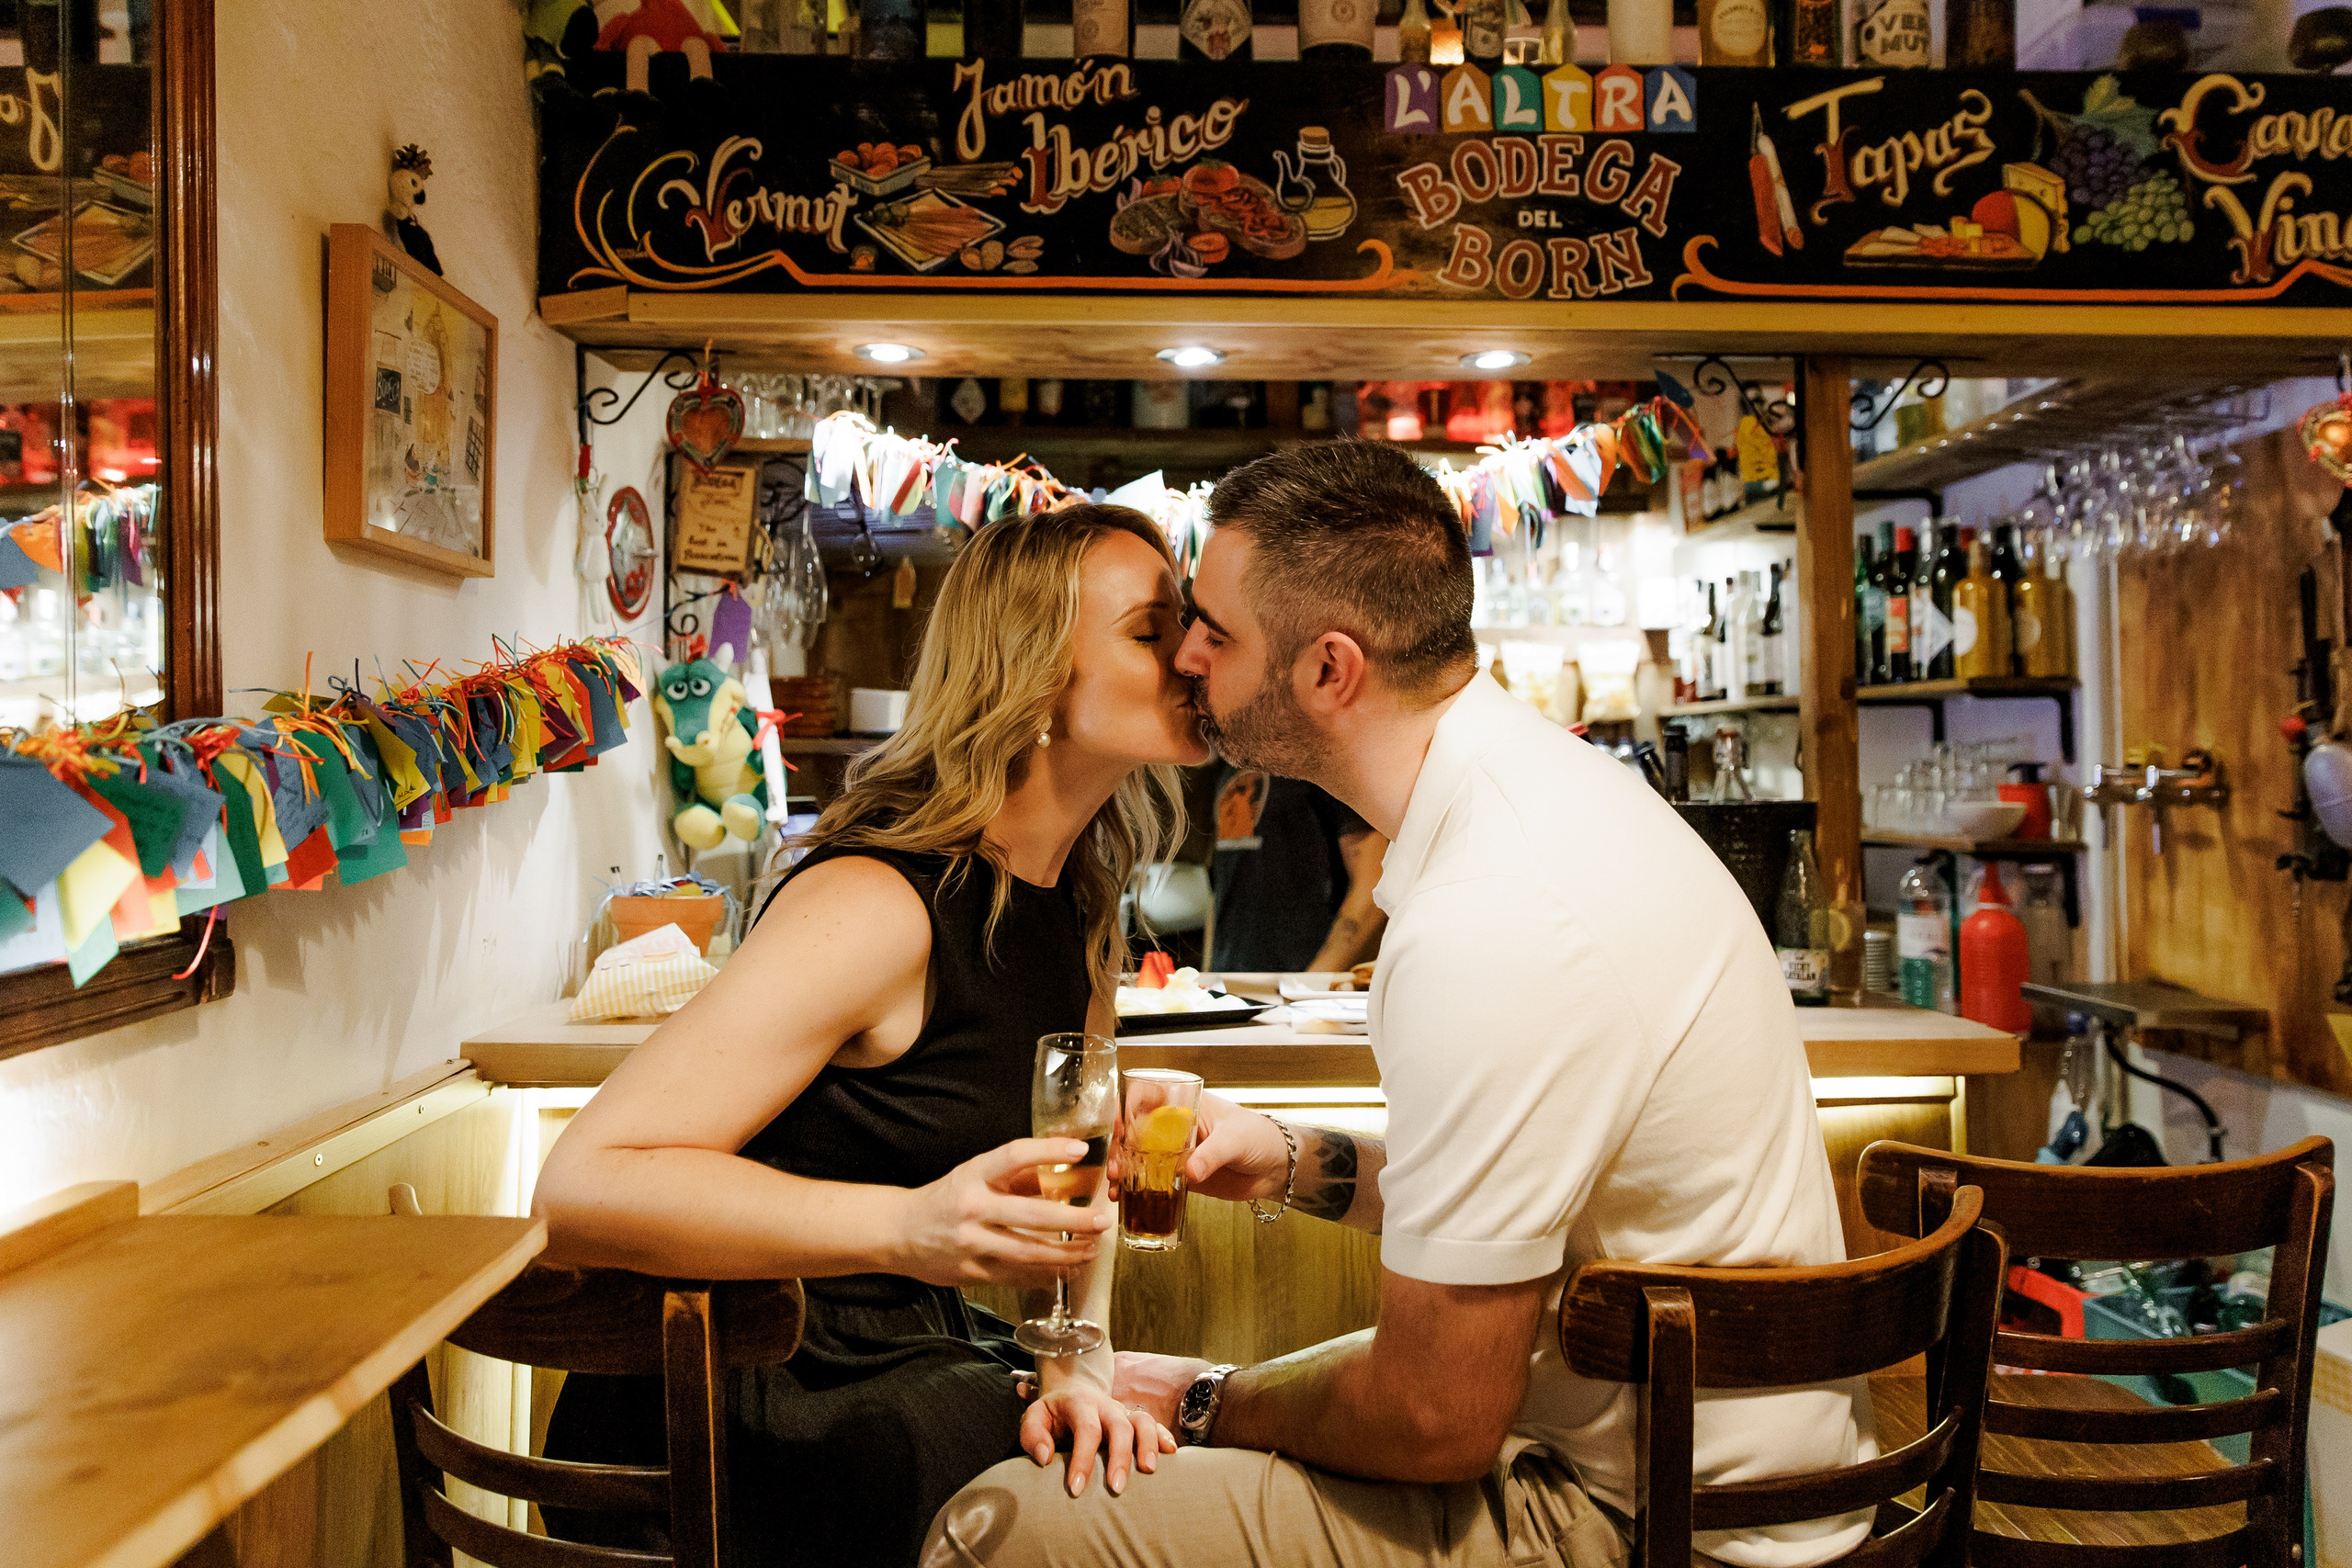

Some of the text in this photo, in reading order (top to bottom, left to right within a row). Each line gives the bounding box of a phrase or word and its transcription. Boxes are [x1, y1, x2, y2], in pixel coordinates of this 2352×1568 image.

[953, 57, 1137, 163] Jamón
[1393, 69, 1693, 130] L'ALTRA
[1781, 75, 1996, 226] Tapas
[657, 135, 859, 264] Vermut
[1019, 96, 1250, 215] Ibérico
[1396, 134, 1682, 239] BODEGA
[1436, 222, 1655, 300] BORN
[1517, 209, 1564, 230] DEL
